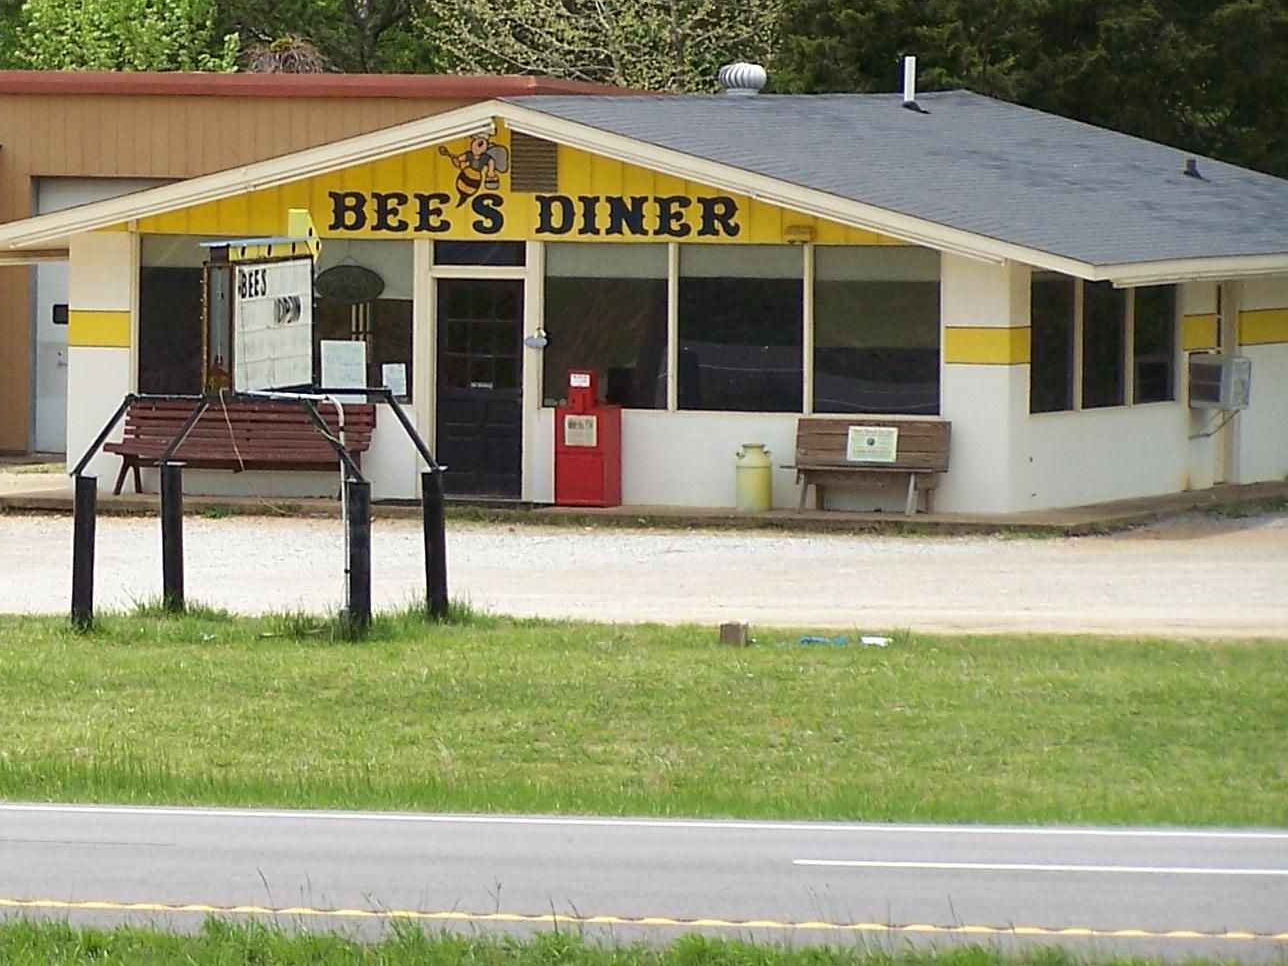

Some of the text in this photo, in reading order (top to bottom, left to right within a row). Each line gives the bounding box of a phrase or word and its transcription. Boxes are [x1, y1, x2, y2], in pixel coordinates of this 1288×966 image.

[328, 191, 741, 237] BEE'S DINER
[240, 268, 267, 299] BEES
